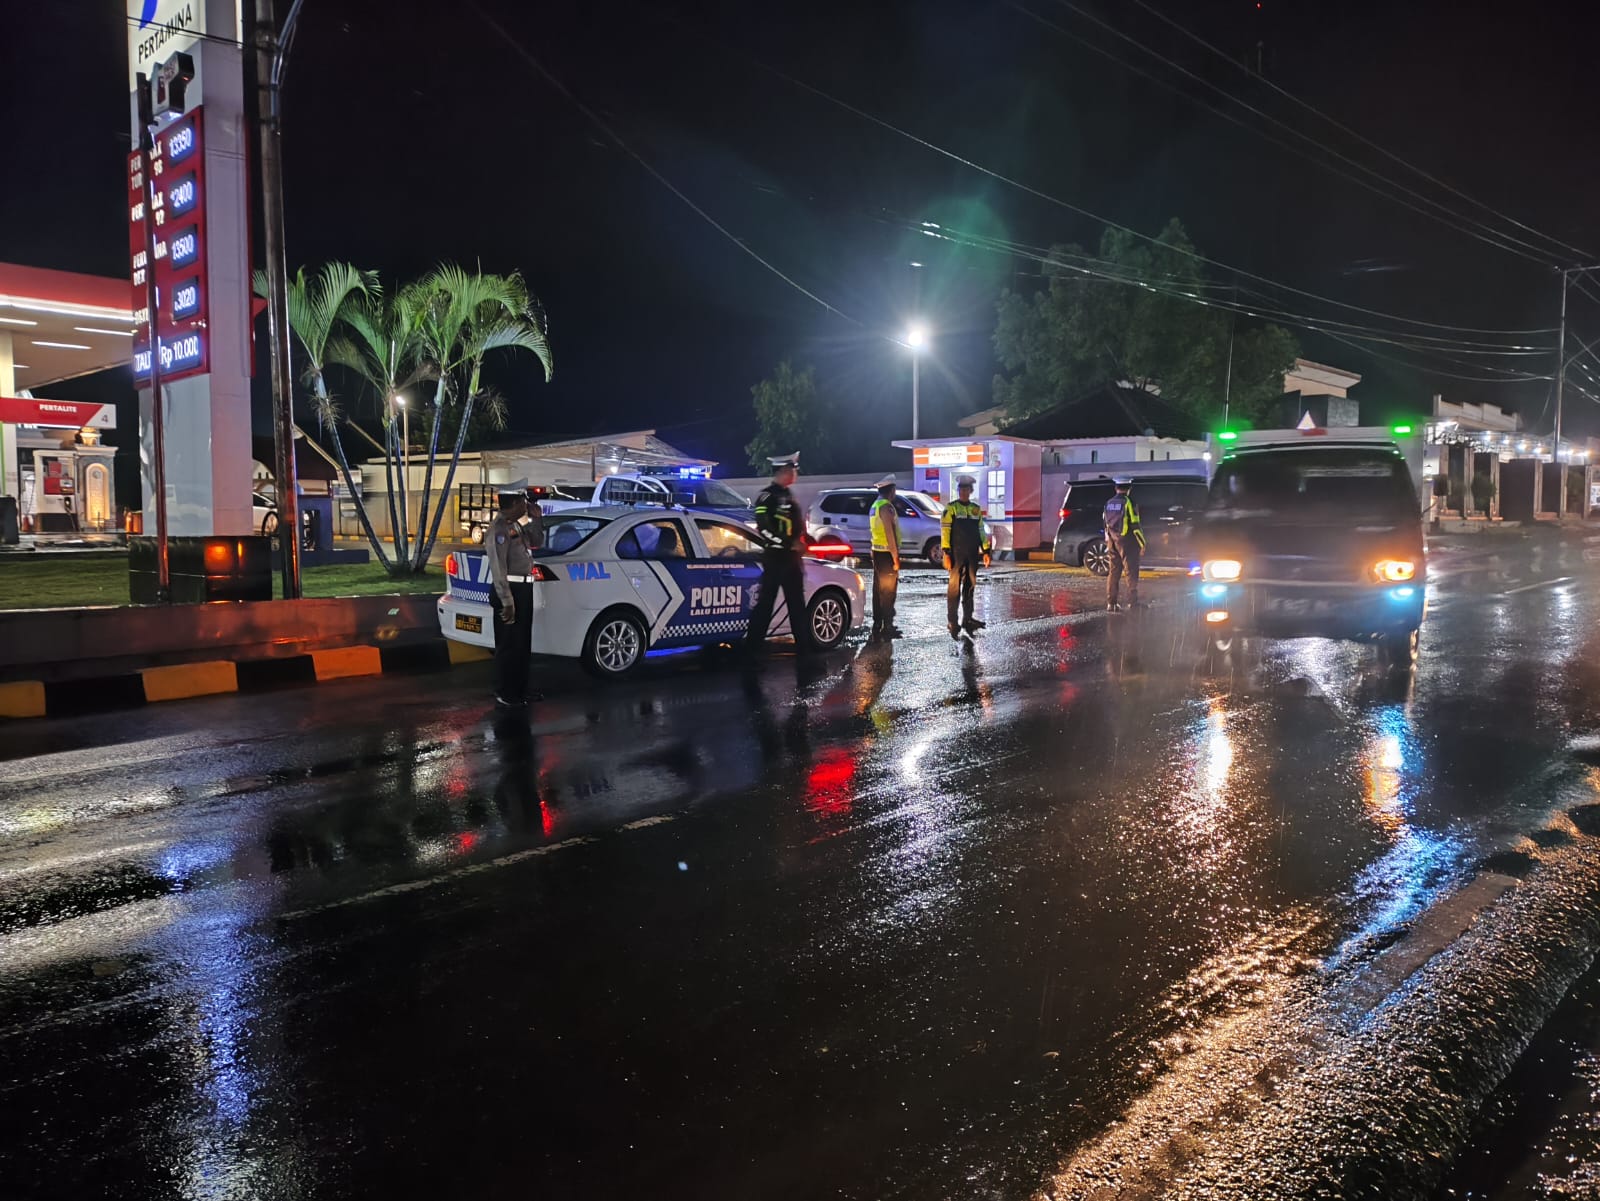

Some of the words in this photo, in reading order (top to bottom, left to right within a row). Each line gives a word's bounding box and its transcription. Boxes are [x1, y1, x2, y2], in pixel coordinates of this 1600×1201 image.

[138, 3, 192, 64] PERTAMINA
[39, 404, 77, 413] PERTALITE
[101, 414, 109, 423] 4
[566, 561, 611, 582] WAL
[690, 585, 742, 609] POLISI
[690, 607, 711, 616] LALU
[712, 606, 741, 615] LINTAS
